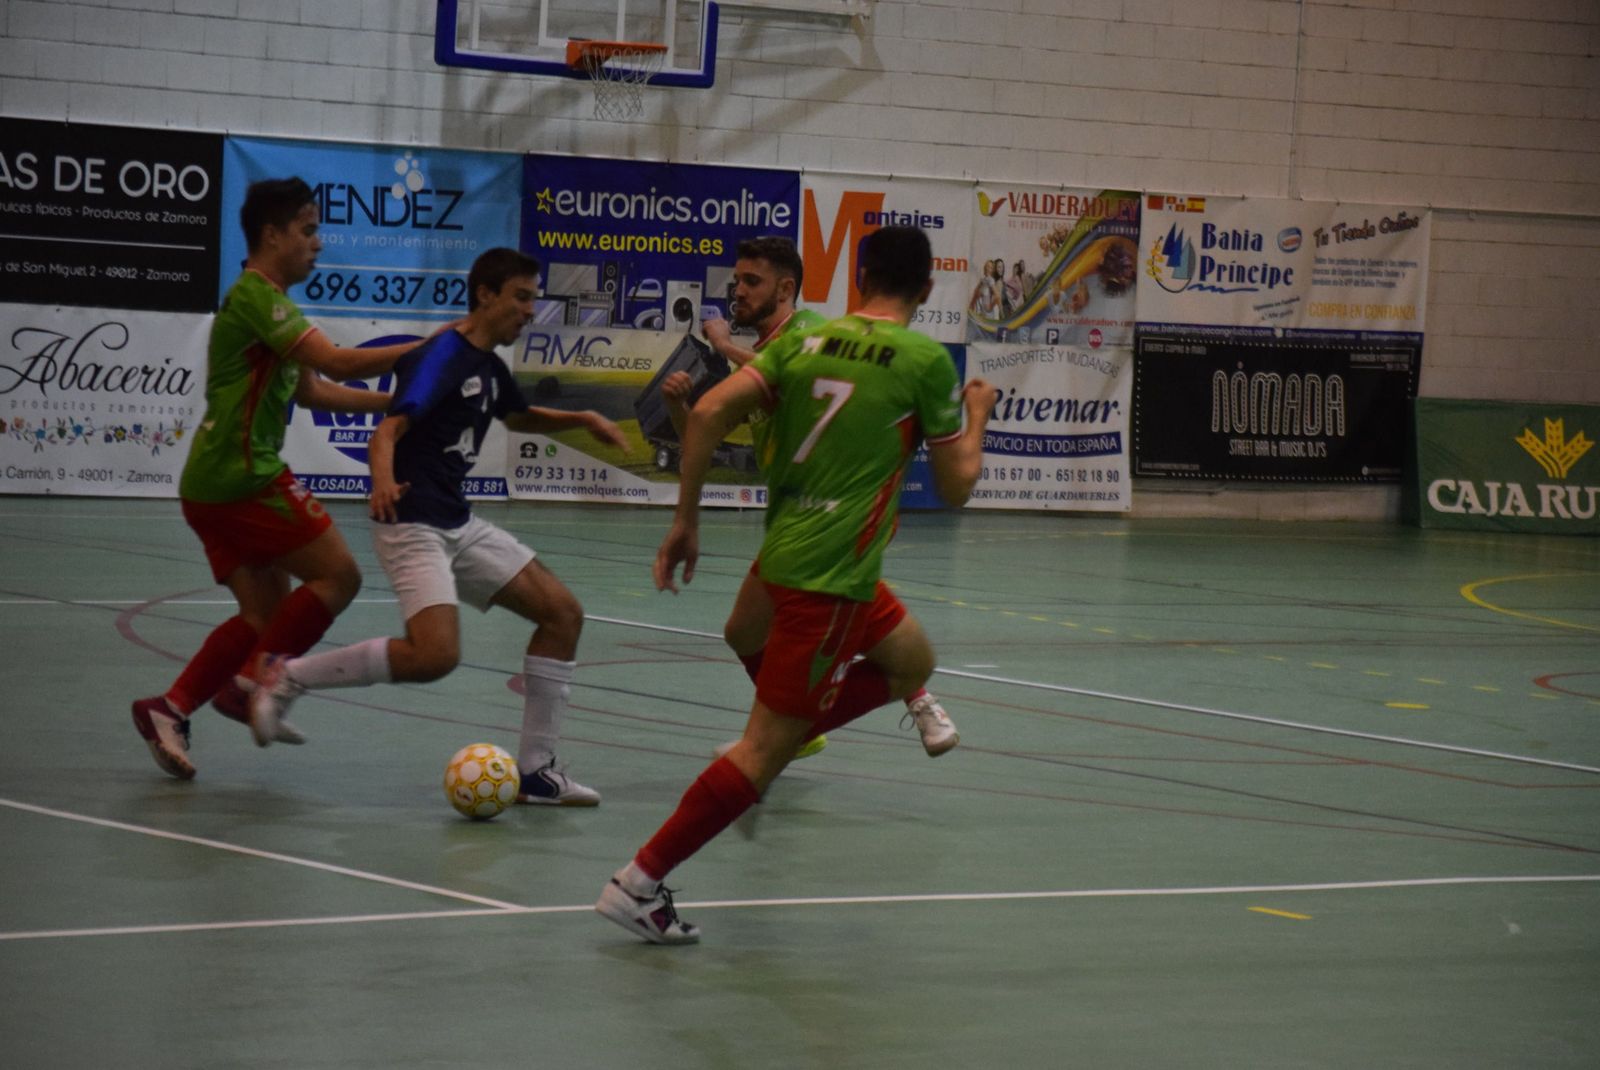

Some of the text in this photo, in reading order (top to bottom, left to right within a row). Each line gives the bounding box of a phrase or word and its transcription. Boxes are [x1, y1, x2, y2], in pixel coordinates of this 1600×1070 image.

[54, 155, 106, 194] DE
[119, 160, 210, 201] ORO
[0, 202, 32, 215] ulces
[82, 205, 142, 222] Productos
[145, 211, 160, 221] de
[162, 211, 208, 226] Zamora
[555, 186, 791, 228] euronics.online
[538, 231, 724, 256] www.euronics.es
[22, 261, 46, 273] San
[49, 263, 88, 279] Miguel
[146, 268, 190, 282] Zamora
[305, 272, 467, 306] 696 337 82
[928, 310, 942, 324] 73
[946, 311, 961, 325] 39
[522, 332, 612, 365] RMC
[573, 356, 651, 370] REMOLQUES
[10, 400, 194, 415] productos zamoranos
[792, 377, 855, 464] 7
[334, 431, 355, 442] BAR
[981, 436, 1023, 451] ERVICIO
[1027, 439, 1042, 452] EN
[1046, 439, 1077, 453] TODA
[57, 467, 66, 480] 9
[77, 468, 114, 482] 49001
[126, 470, 173, 484] Zamora
[514, 465, 608, 482] 679 33 13 14
[994, 467, 1006, 480] 16
[1010, 467, 1023, 481] 67
[1028, 467, 1041, 481] 00
[1091, 470, 1102, 482] 18
[1107, 470, 1120, 483] 90
[309, 477, 368, 492] LOSADA,
[483, 481, 503, 493] 581
[515, 483, 649, 498] www.rmcremolques.com
[1427, 478, 1600, 519] CAJA RU
